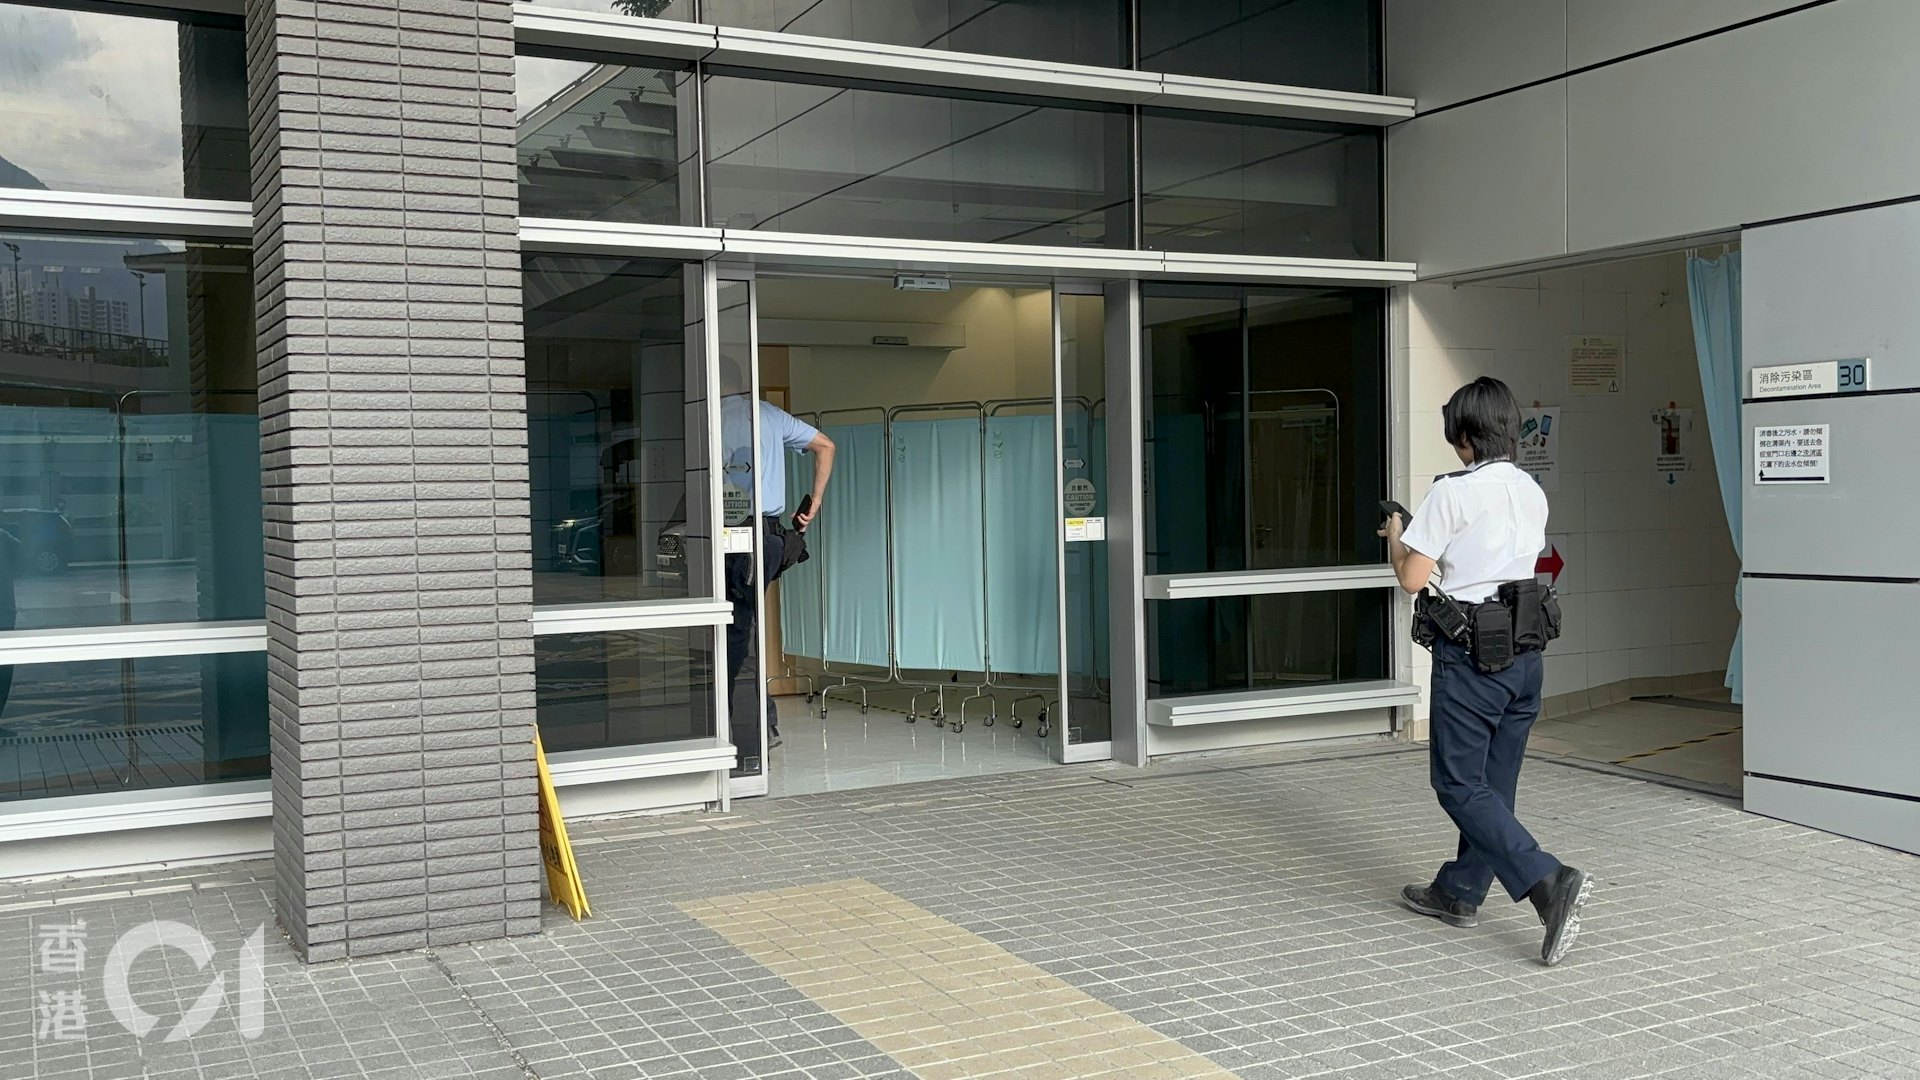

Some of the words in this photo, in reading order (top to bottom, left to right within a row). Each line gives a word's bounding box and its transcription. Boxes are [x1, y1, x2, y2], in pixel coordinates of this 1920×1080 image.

[1759, 369, 1813, 385] 消除污染區
[1839, 364, 1865, 387] 30
[1759, 384, 1807, 393] Decontamination
